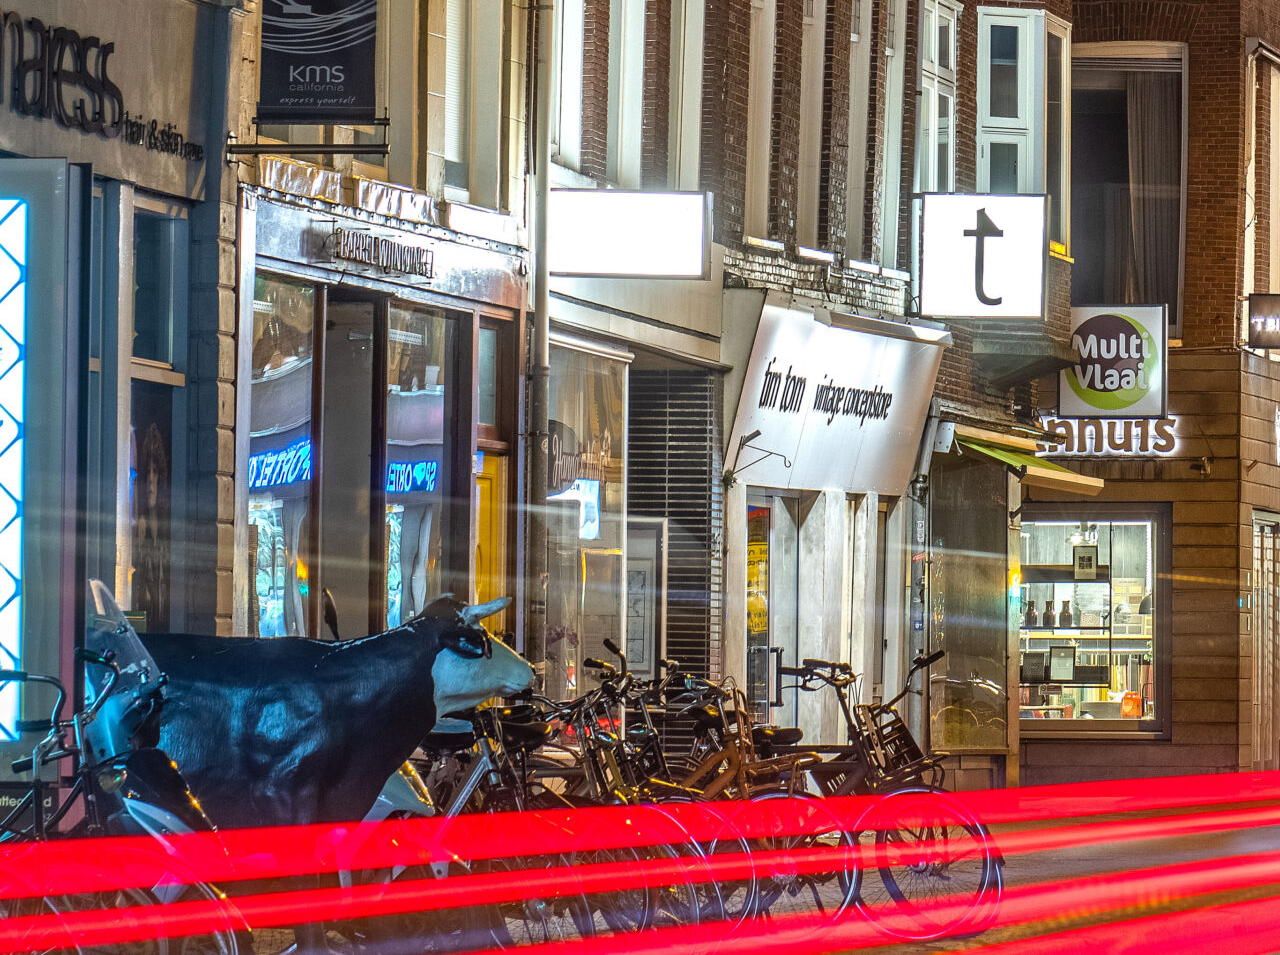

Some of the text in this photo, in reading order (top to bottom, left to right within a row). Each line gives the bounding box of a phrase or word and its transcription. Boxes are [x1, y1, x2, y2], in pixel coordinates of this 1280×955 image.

[289, 82, 345, 92] california
[280, 96, 357, 107] express yourself
[963, 207, 1004, 306] t
[1071, 331, 1151, 359] Multi
[1074, 362, 1148, 391] Vlaai
